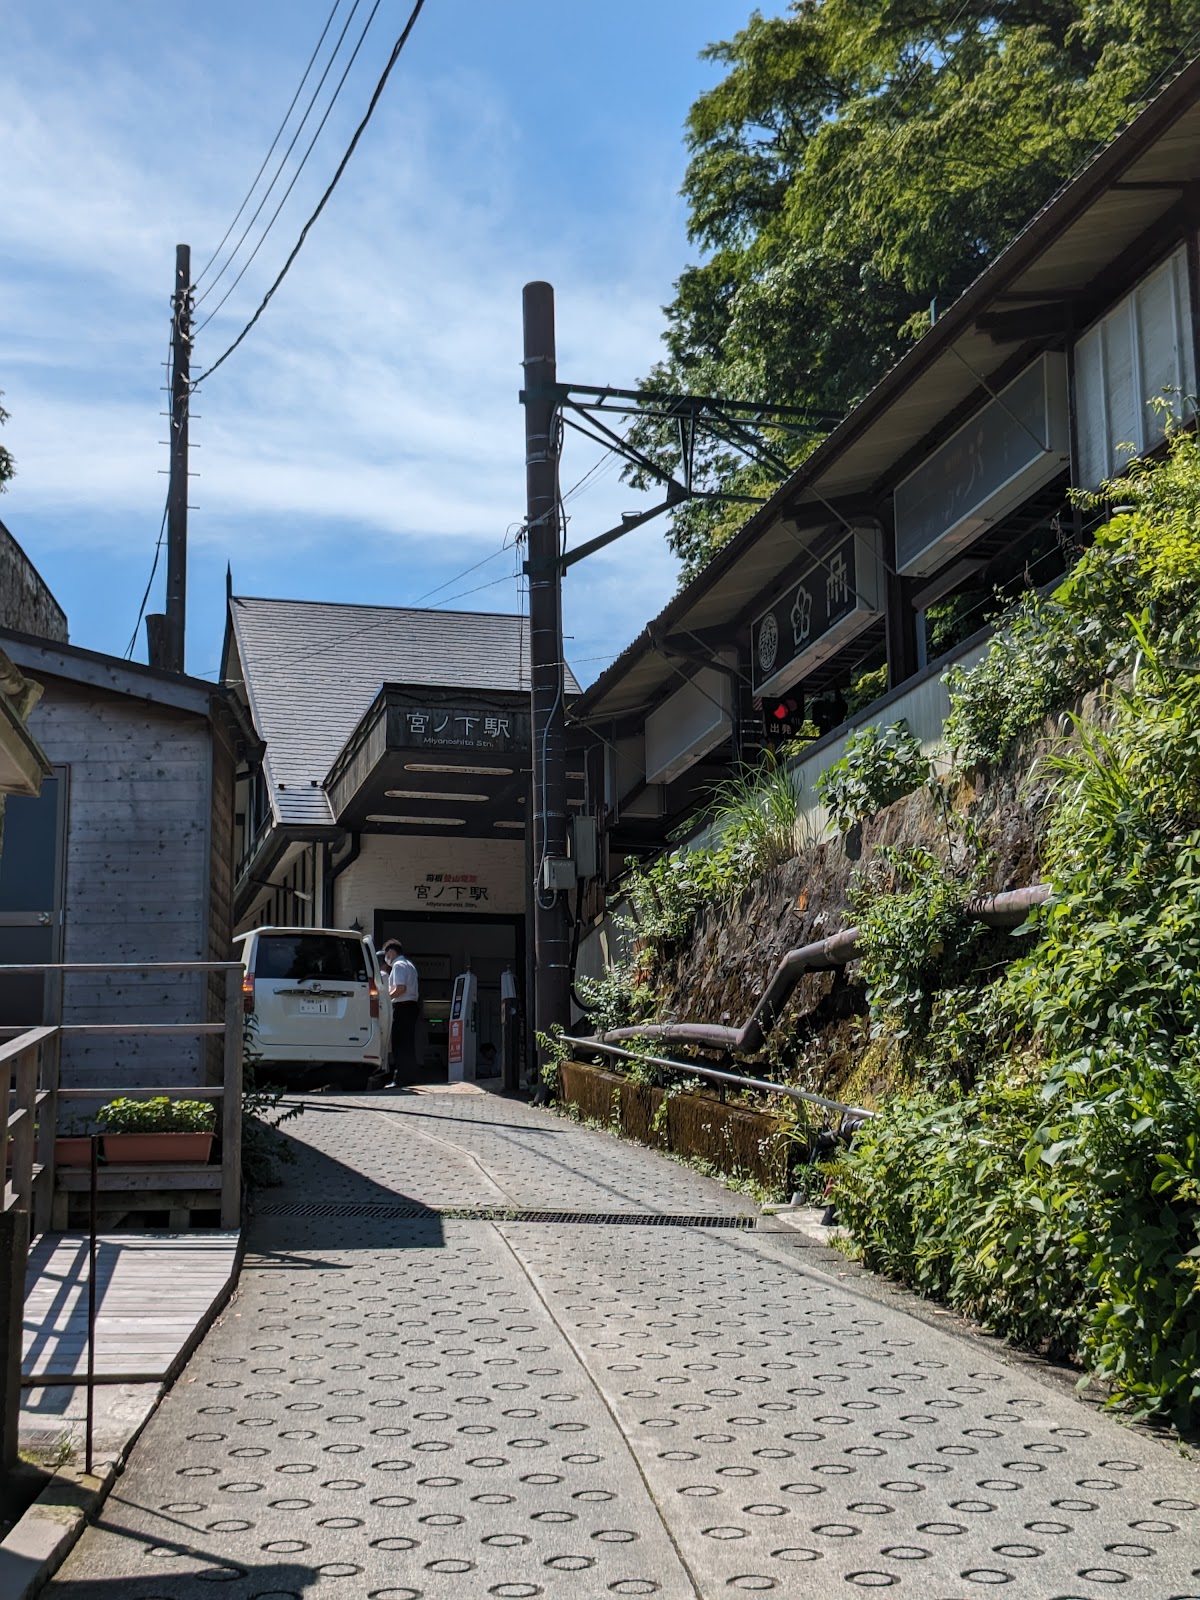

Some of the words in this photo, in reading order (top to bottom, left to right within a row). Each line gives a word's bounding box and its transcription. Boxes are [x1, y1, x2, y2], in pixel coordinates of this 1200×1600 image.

[406, 712, 511, 738] 宮ノ下駅
[423, 737, 474, 747] Miyanoshita
[476, 740, 494, 748] Stn.
[414, 884, 488, 901] 宮ノ下駅
